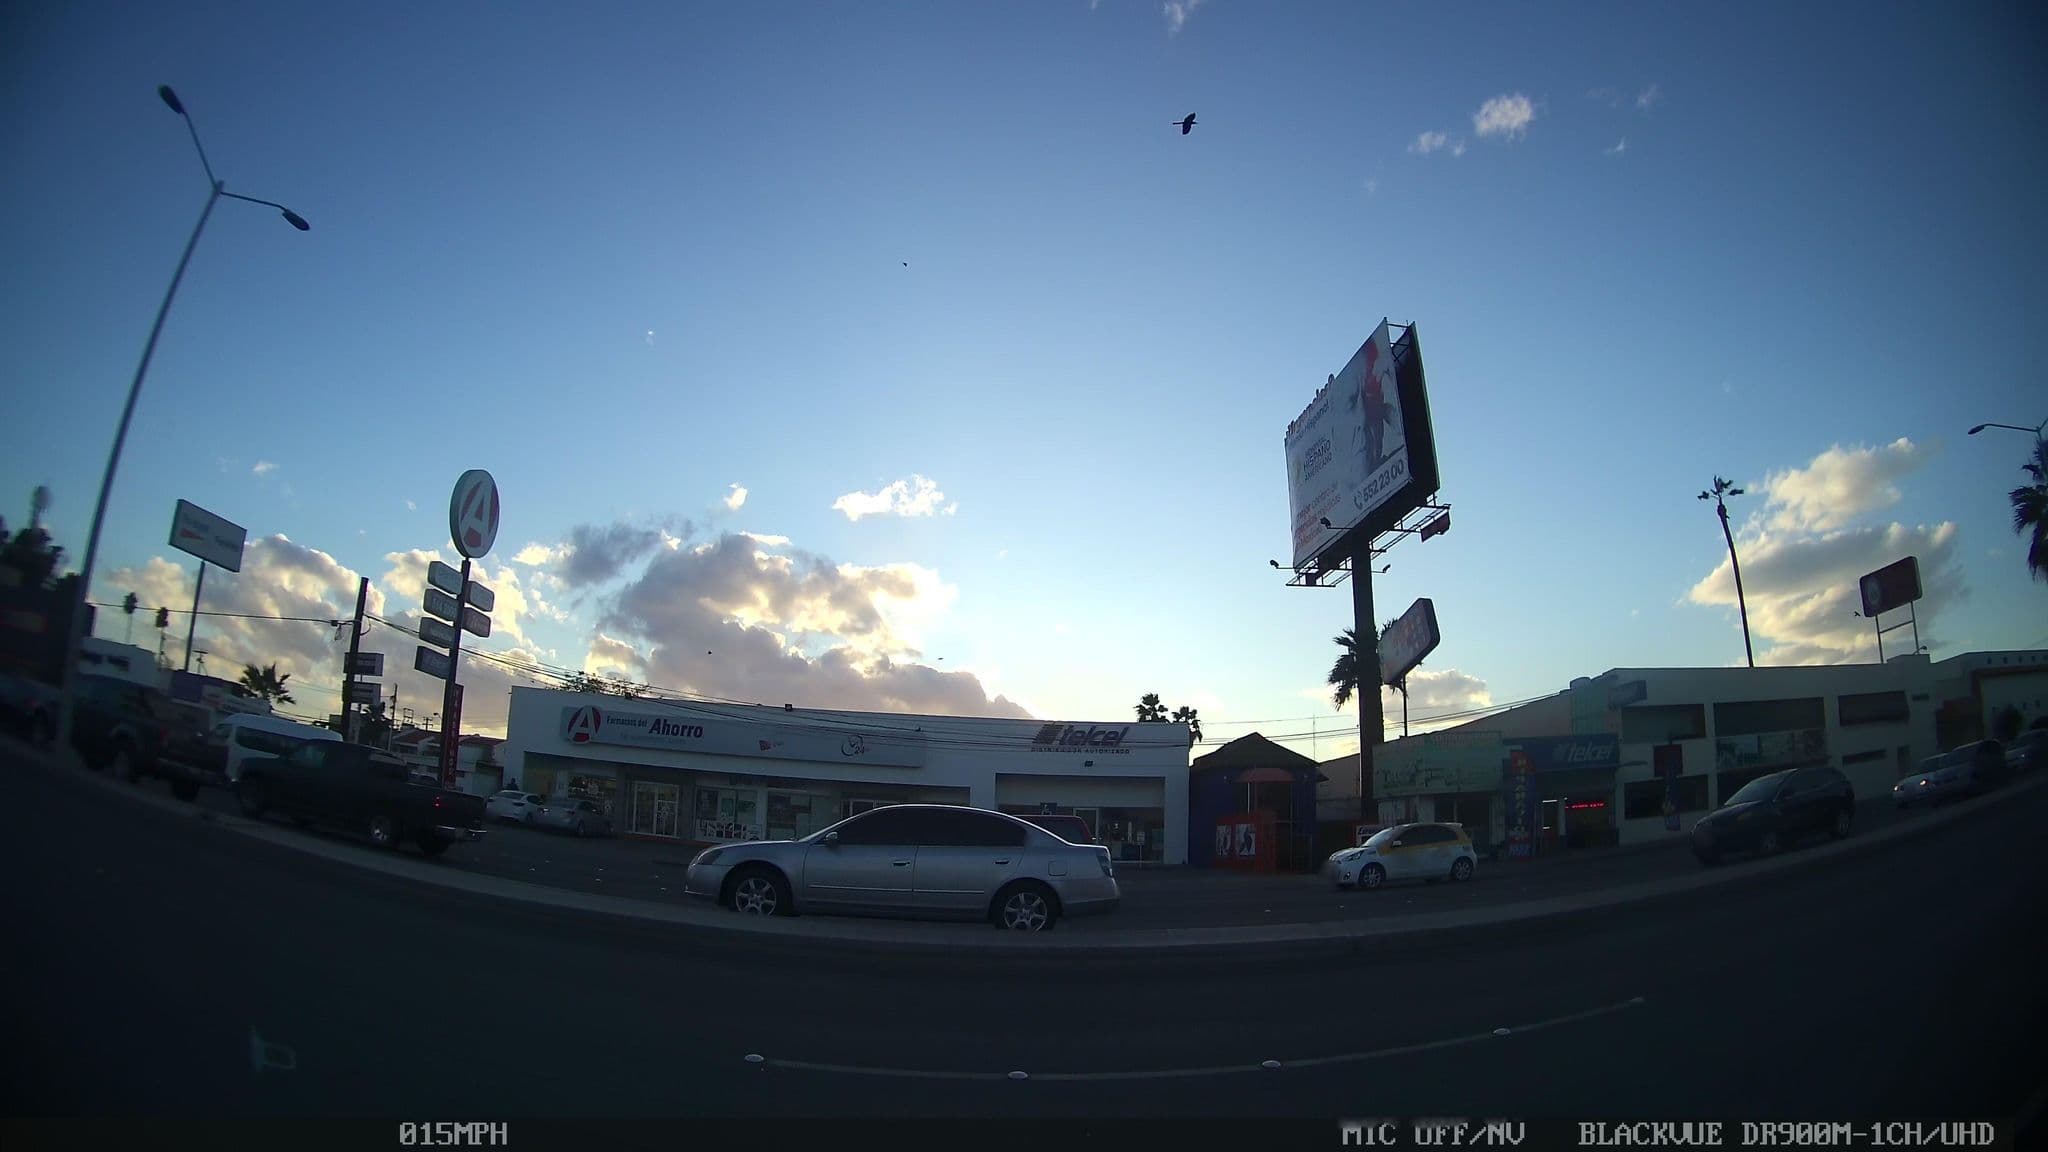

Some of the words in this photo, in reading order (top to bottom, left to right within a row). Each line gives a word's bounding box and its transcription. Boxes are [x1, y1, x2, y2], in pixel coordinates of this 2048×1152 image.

[1304, 439, 1331, 471] HISPANO
[1363, 480, 1378, 502] 552
[1379, 474, 1391, 491] 23
[1391, 460, 1404, 478] 00
[607, 715, 636, 728] Farmacias
[638, 719, 648, 728] del
[649, 718, 704, 738] Ahorro
[1058, 724, 1130, 747] telcel
[1567, 741, 1616, 762] telcel
